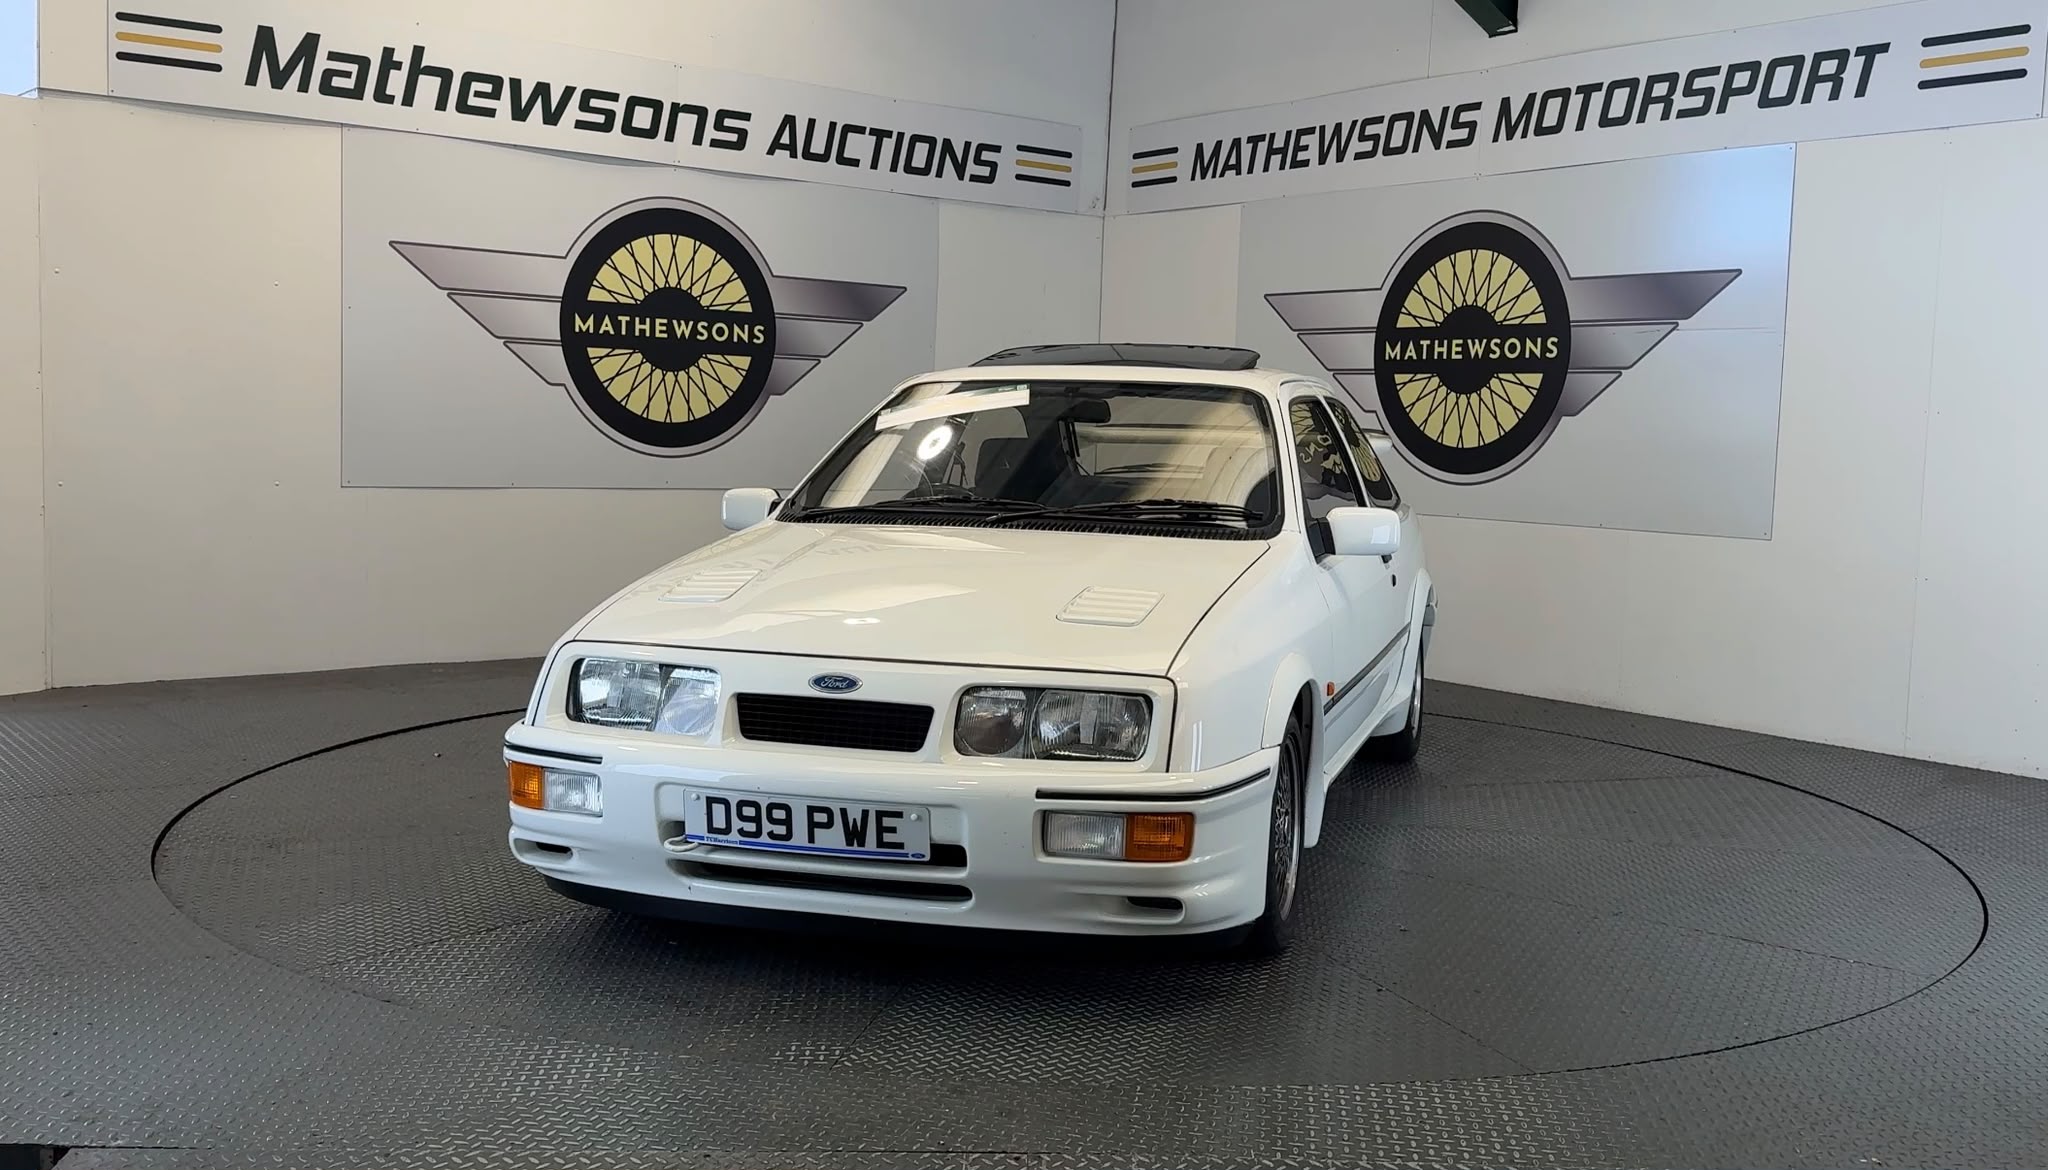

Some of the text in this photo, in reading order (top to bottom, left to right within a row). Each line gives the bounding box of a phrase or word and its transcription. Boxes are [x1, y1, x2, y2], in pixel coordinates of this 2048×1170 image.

[245, 25, 1002, 185] Mathewsons AUCTIONS
[1190, 42, 1891, 182] MATHEWSONS MOTORSPORT
[574, 313, 765, 345] MATHEWSONS
[1384, 337, 1560, 361] MATHEWSONS
[820, 676, 849, 688] Ford
[705, 796, 906, 851] D99 PWE
